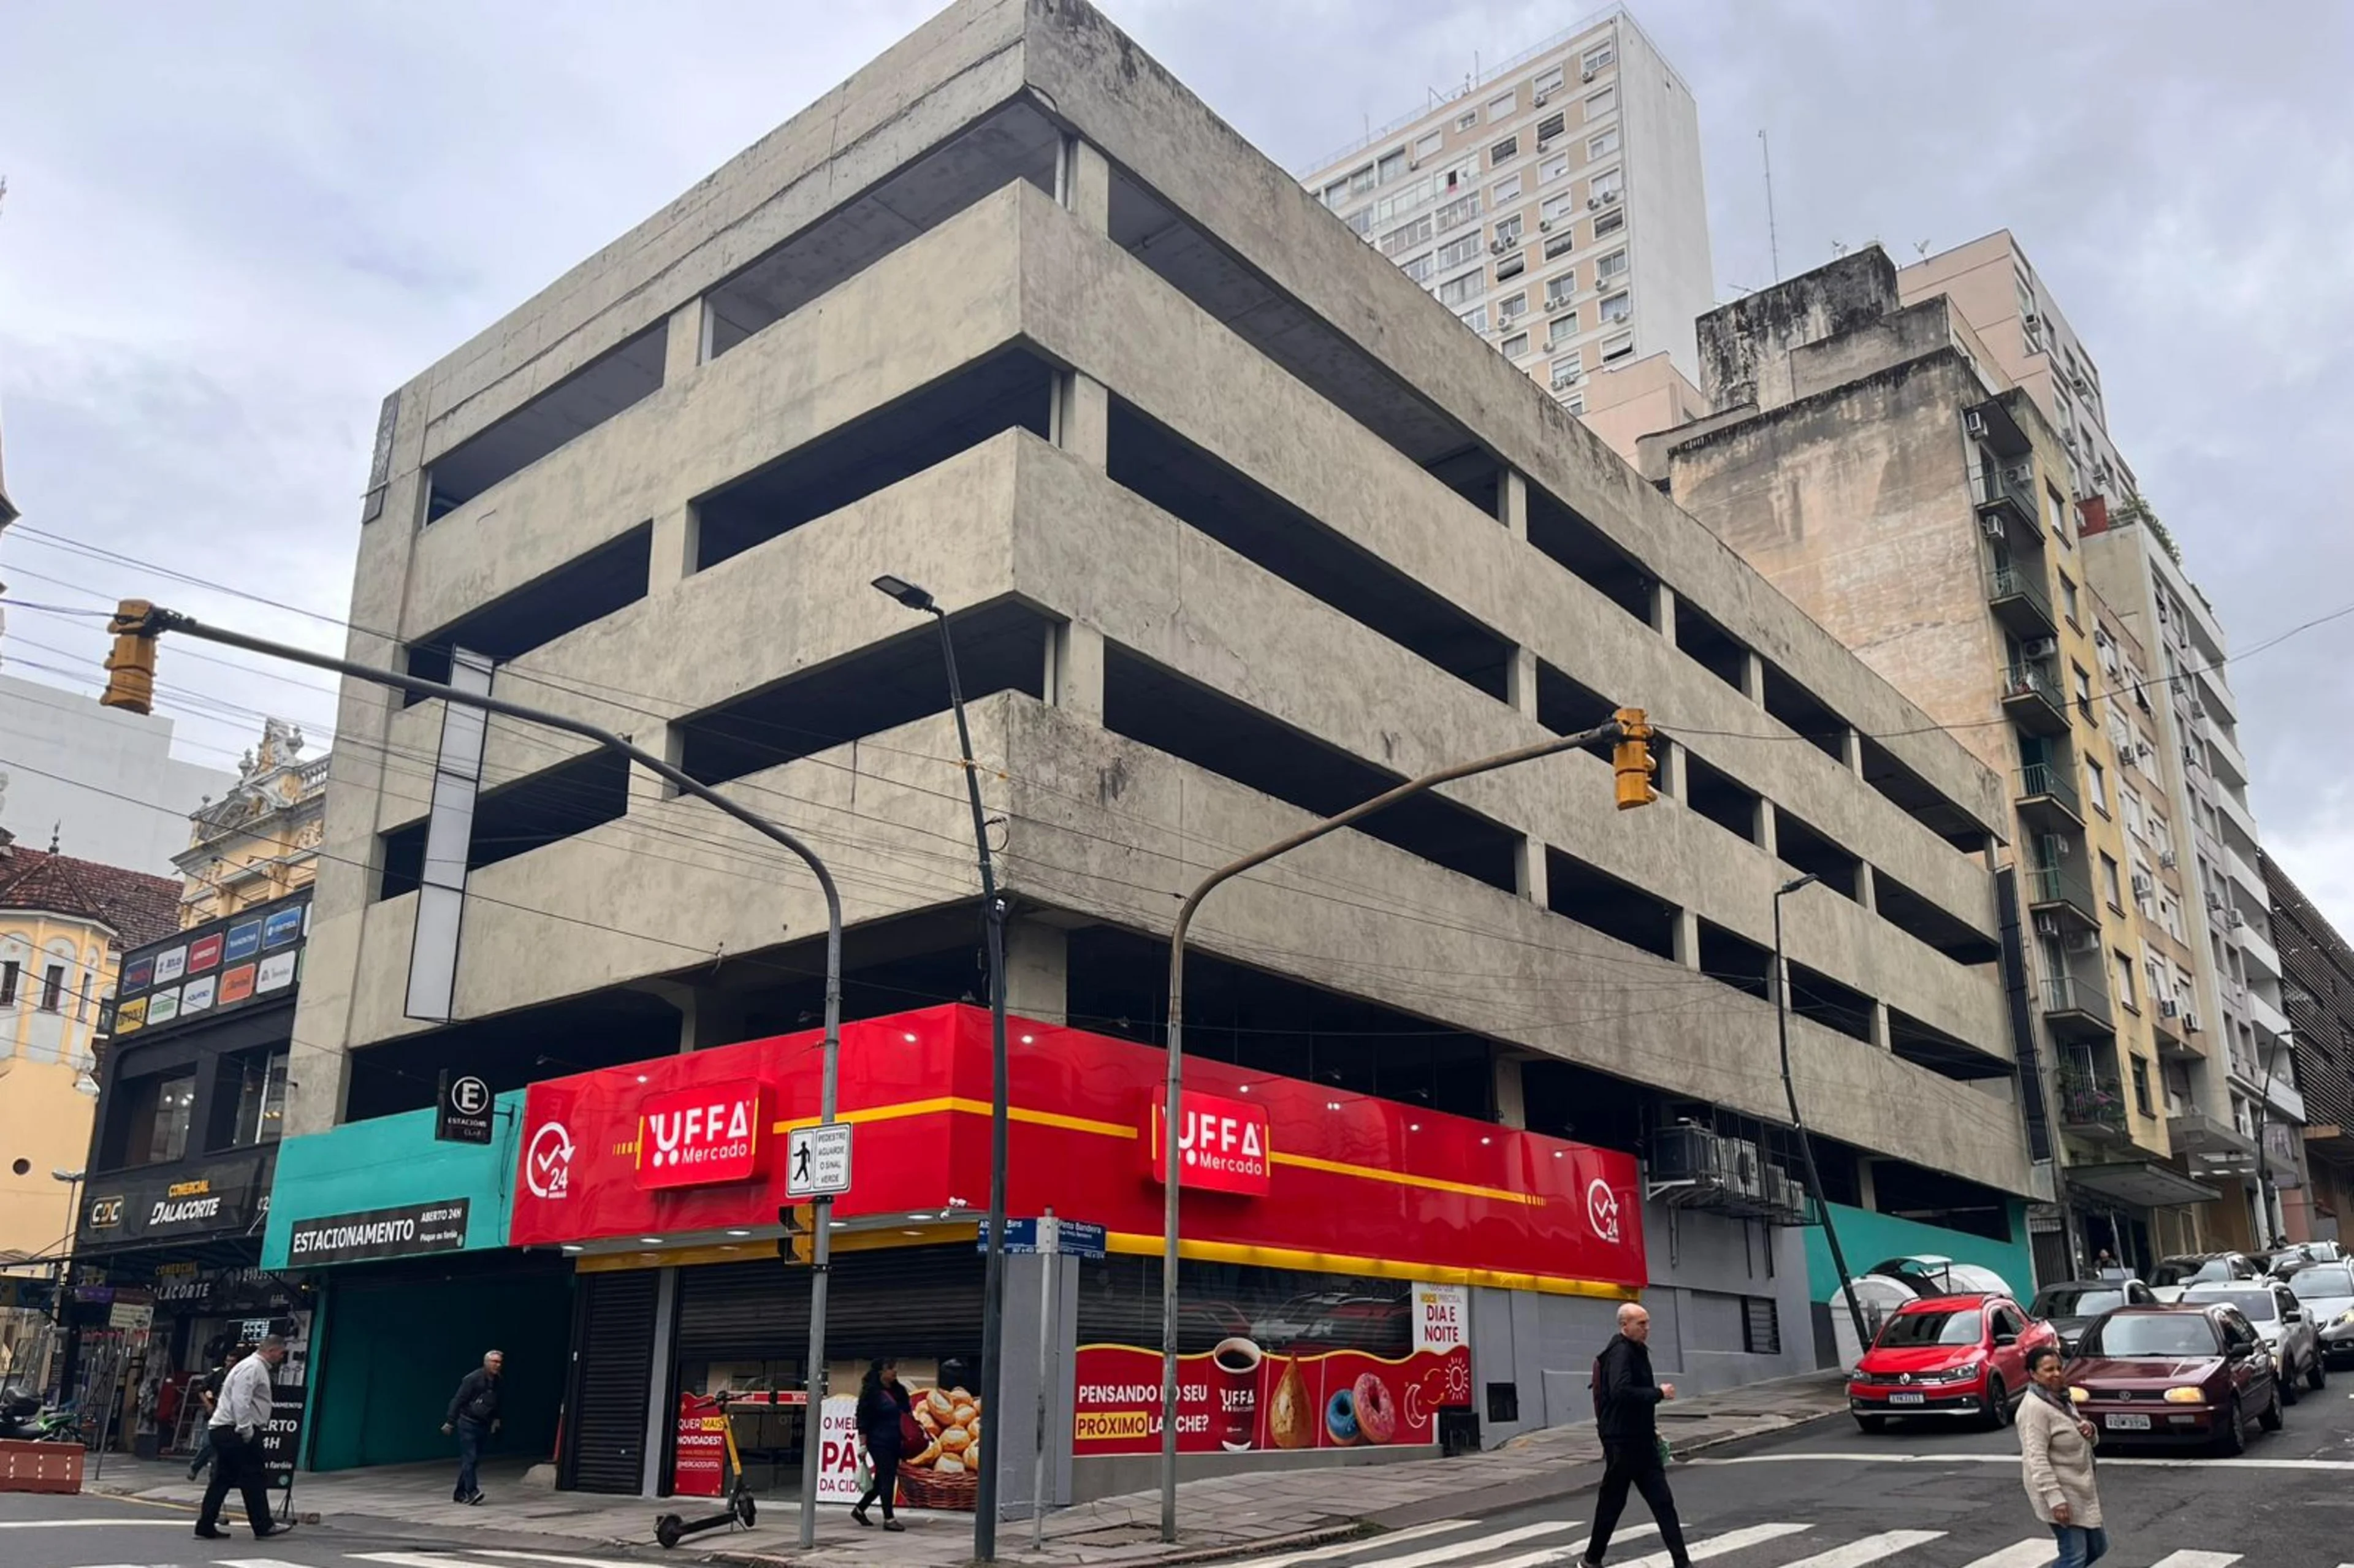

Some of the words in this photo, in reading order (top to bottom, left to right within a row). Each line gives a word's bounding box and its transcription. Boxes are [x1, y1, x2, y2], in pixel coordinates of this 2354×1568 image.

[461, 1083, 480, 1109] E
[649, 1101, 748, 1152] UFFA
[682, 1143, 747, 1164] Mercado
[1200, 1150, 1262, 1175] Mercado
[549, 1165, 568, 1190] 24
[169, 1179, 210, 1198] COMERCIAL
[93, 1201, 122, 1222] CDC
[150, 1197, 221, 1225] DALACORTE
[421, 1209, 447, 1223] ABERTO
[293, 1219, 414, 1253] ESTACIONAMENTO
[1606, 1217, 1618, 1237] 24
[158, 1282, 210, 1300] LACORTE
[1427, 1304, 1447, 1322] DIA
[1449, 1306, 1455, 1322] E
[1424, 1325, 1458, 1342] NOITE
[1079, 1385, 1157, 1403] PENSANDO
[1183, 1385, 1207, 1402] SEU
[678, 1418, 700, 1430] QUER
[702, 1417, 723, 1429] MAIS
[823, 1417, 831, 1429] O
[834, 1417, 858, 1430] MEL
[1077, 1414, 1146, 1436] PRÓXIMO
[1148, 1414, 1209, 1434] LACHE?
[677, 1436, 722, 1445] NOVIDADES?
[821, 1433, 857, 1473] PÃ
[820, 1479, 835, 1491] DA
[838, 1479, 861, 1493] CID
